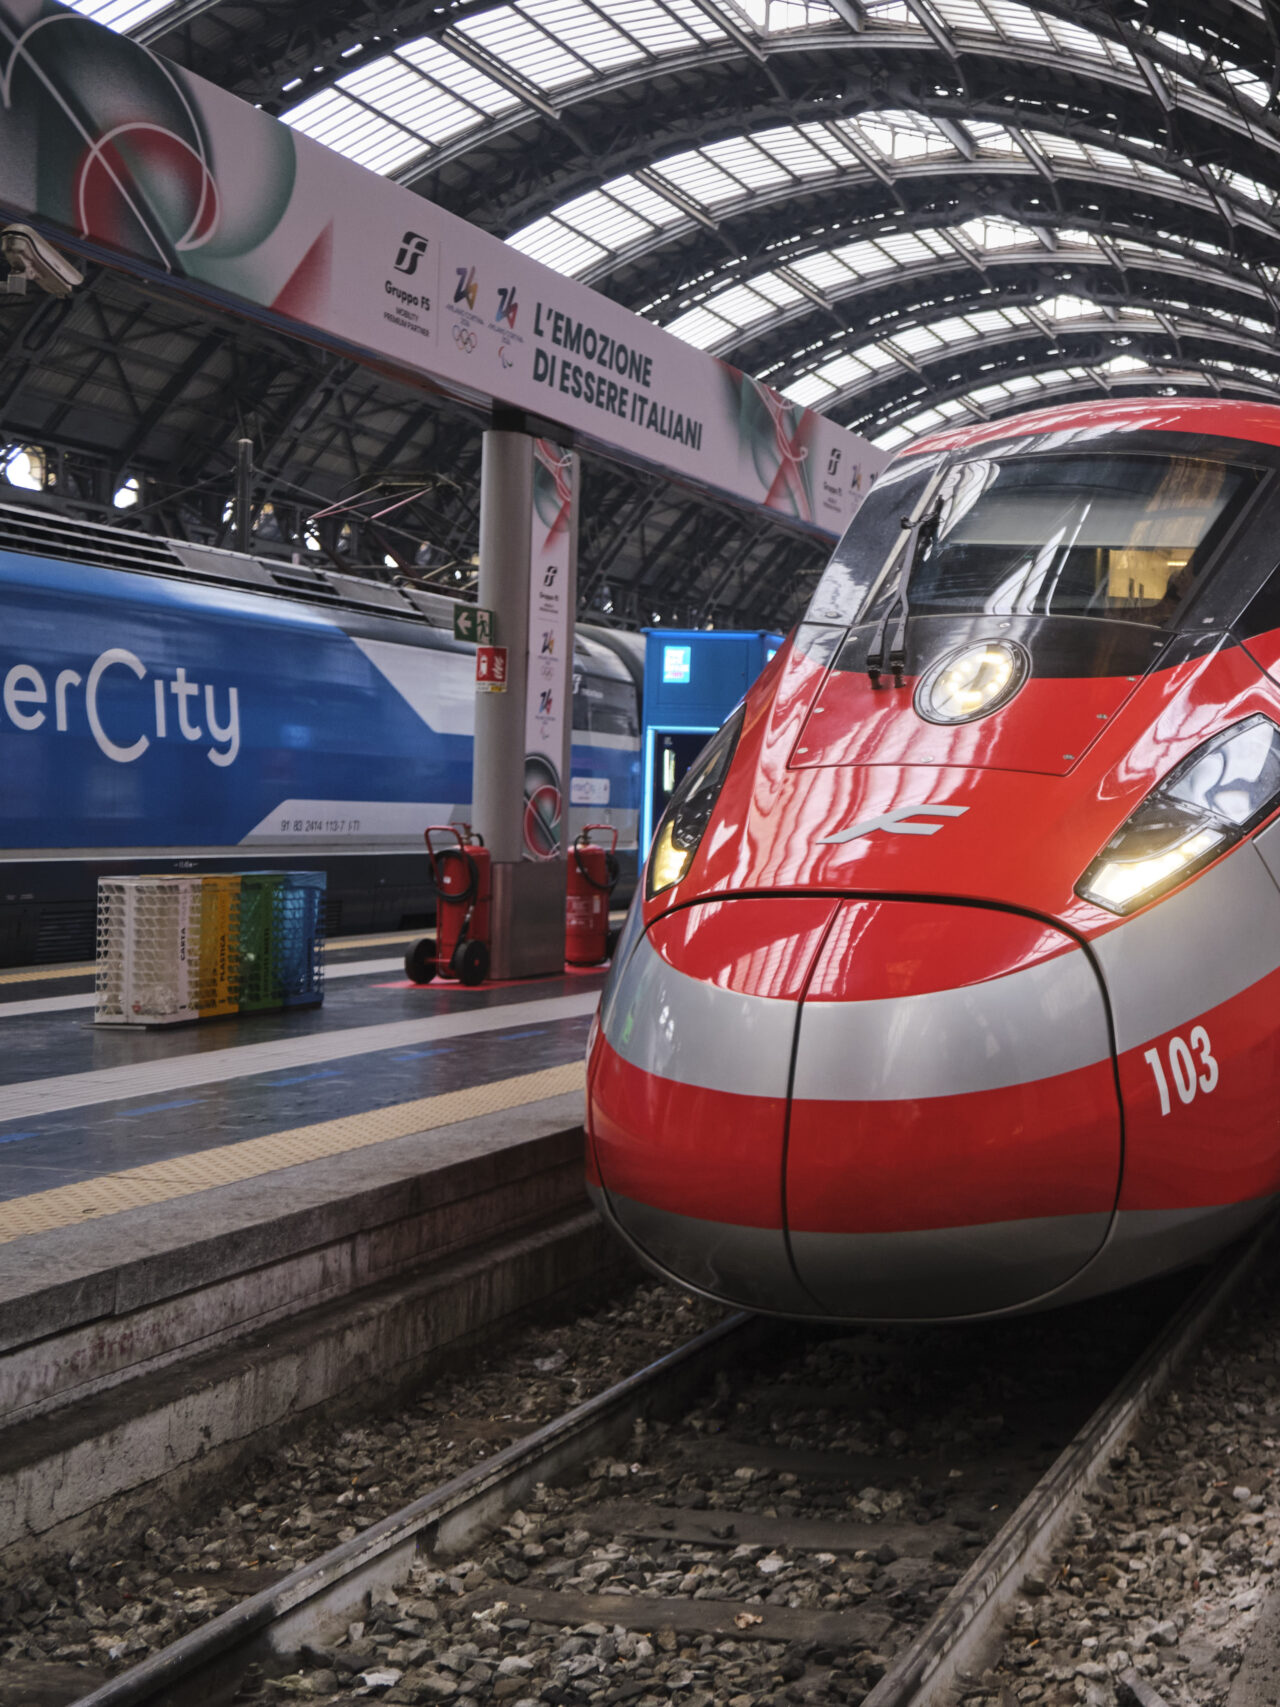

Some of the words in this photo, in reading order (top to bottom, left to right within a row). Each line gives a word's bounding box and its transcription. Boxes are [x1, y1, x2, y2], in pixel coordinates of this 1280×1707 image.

[385, 280, 418, 306] Gruppo
[420, 296, 431, 311] FS
[533, 302, 653, 388] L'EMOZIONE
[532, 348, 556, 387] DI
[559, 360, 629, 418] ESSERE
[630, 392, 703, 451] ITALIANI
[1143, 1025, 1219, 1117] 103
